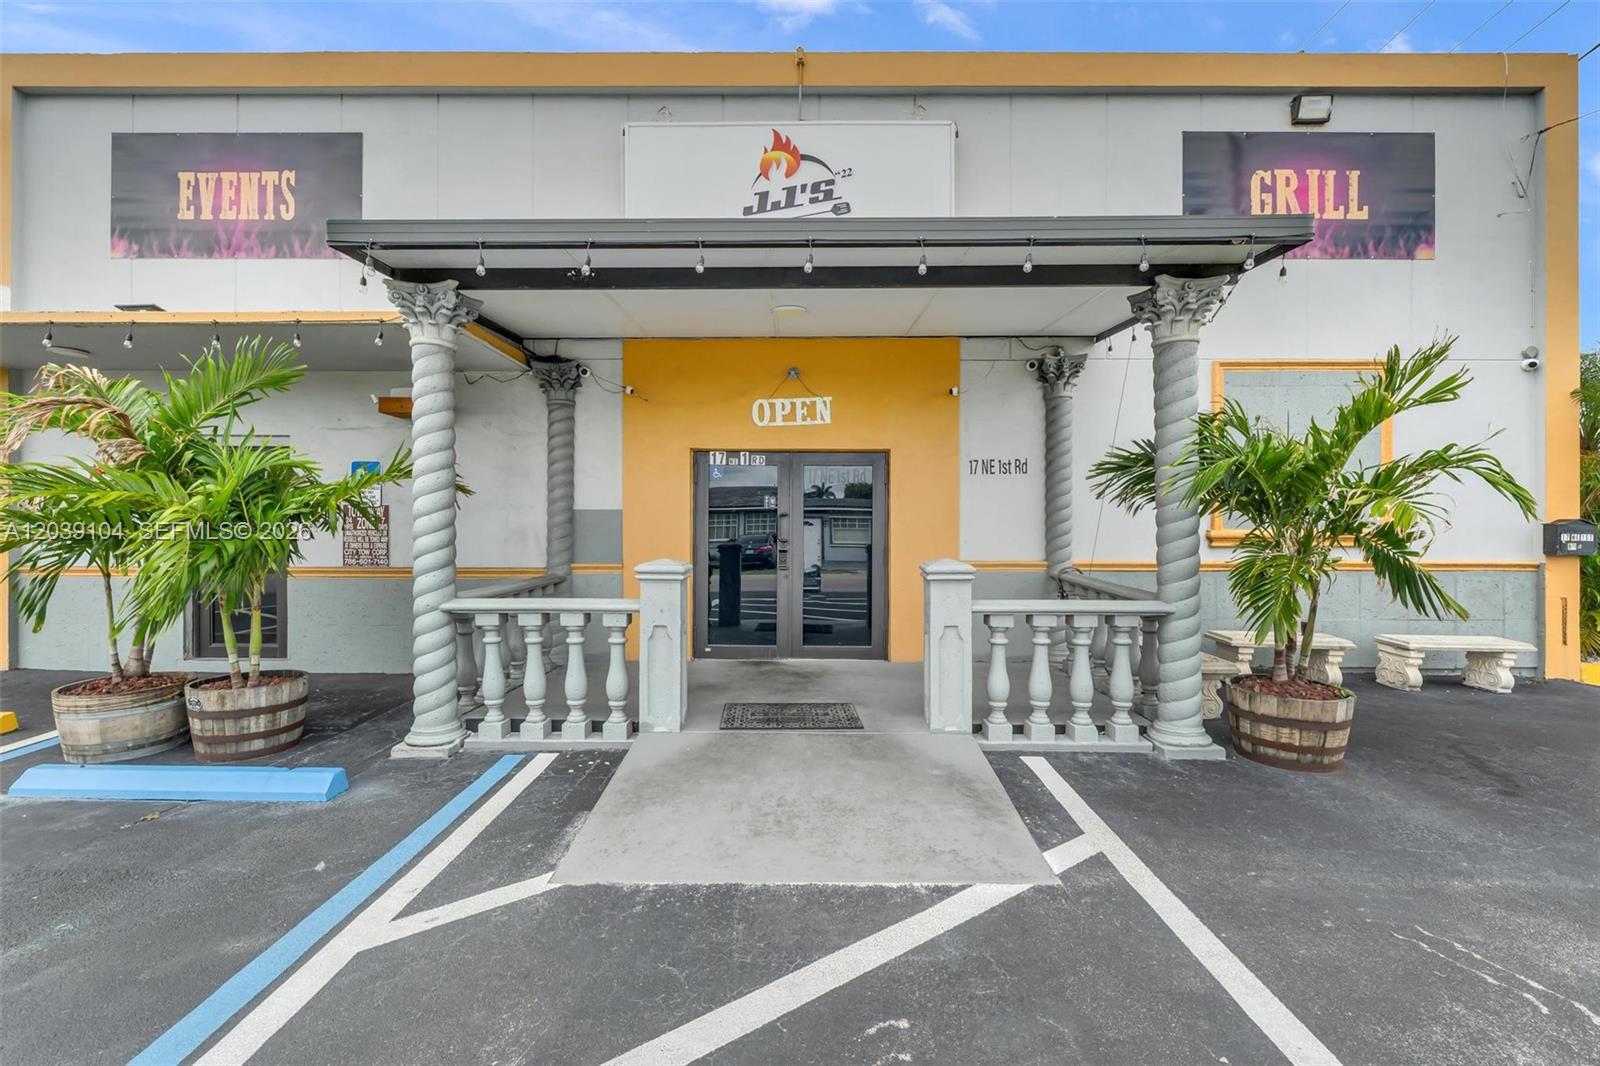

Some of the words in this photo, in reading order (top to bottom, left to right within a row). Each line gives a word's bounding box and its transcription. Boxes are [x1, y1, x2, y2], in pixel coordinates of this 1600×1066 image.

[176, 170, 296, 221] EVENTS
[742, 178, 842, 217] JJ'S
[1250, 168, 1369, 220] GRILL
[751, 396, 832, 426] OPEN
[710, 452, 726, 465] 17
[751, 456, 765, 466] RD
[968, 459, 979, 475] 17
[981, 459, 995, 475] NE
[998, 459, 1012, 475] 1st
[1014, 457, 1028, 475] Rd
